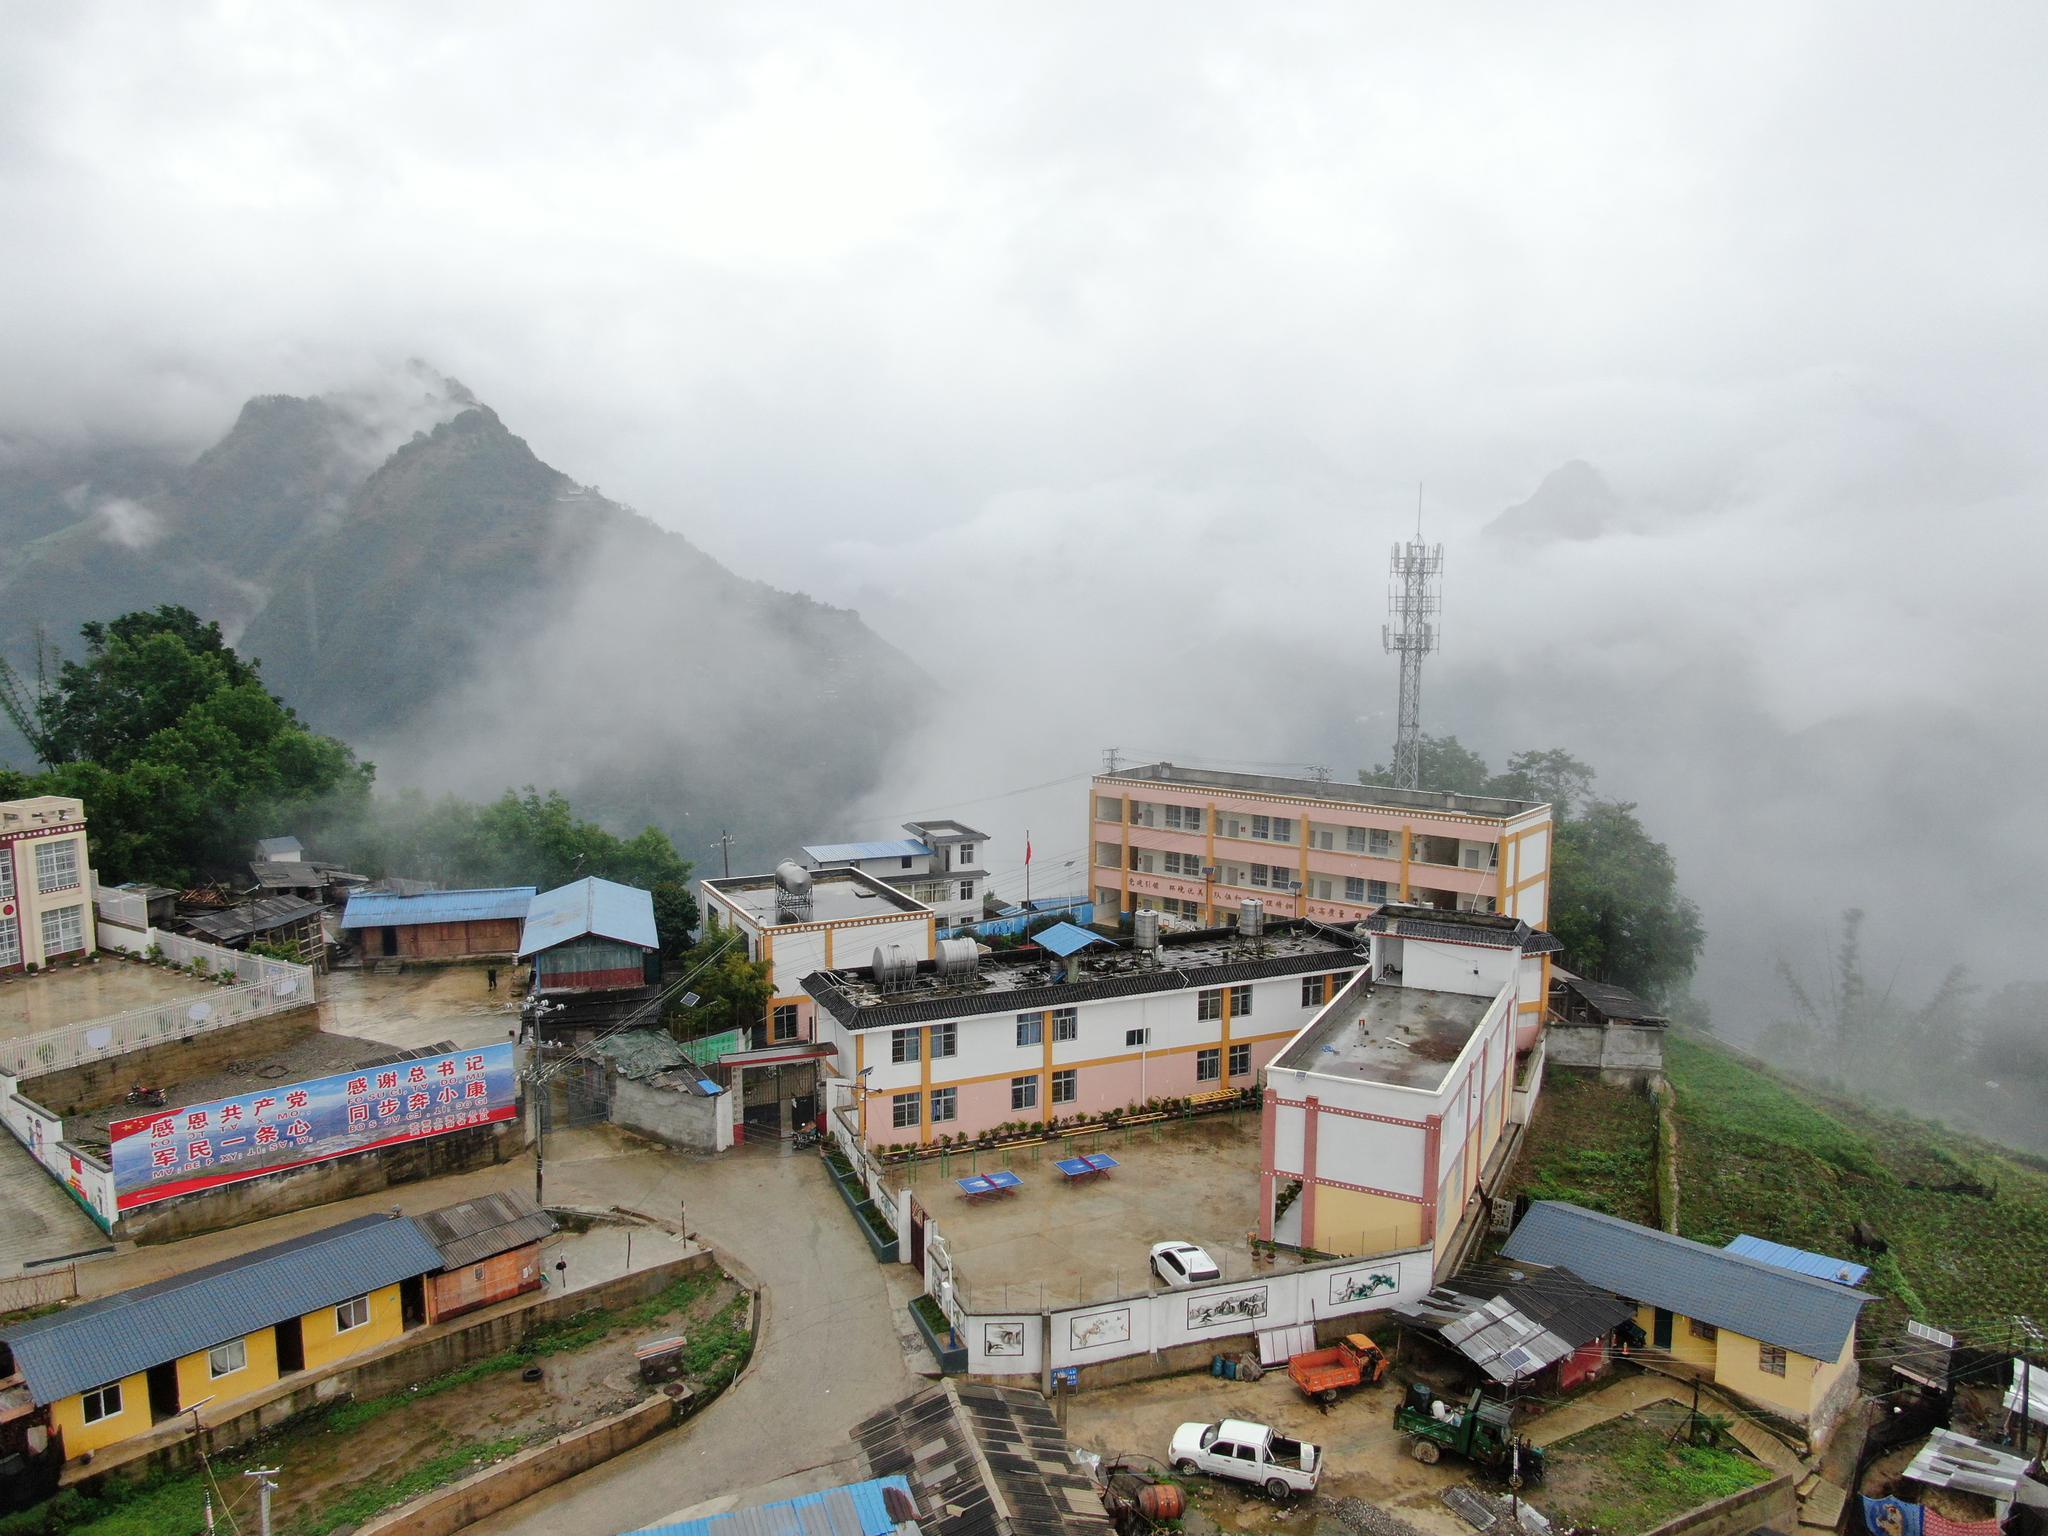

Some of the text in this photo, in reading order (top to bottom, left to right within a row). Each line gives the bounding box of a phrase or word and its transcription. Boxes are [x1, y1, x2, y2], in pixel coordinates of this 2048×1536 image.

[348, 1055, 485, 1095] 感谢总书记
[151, 1090, 309, 1139] 感恩共产党
[349, 1080, 487, 1123] 同步奔小康
[152, 1119, 311, 1168] 军民一条心
